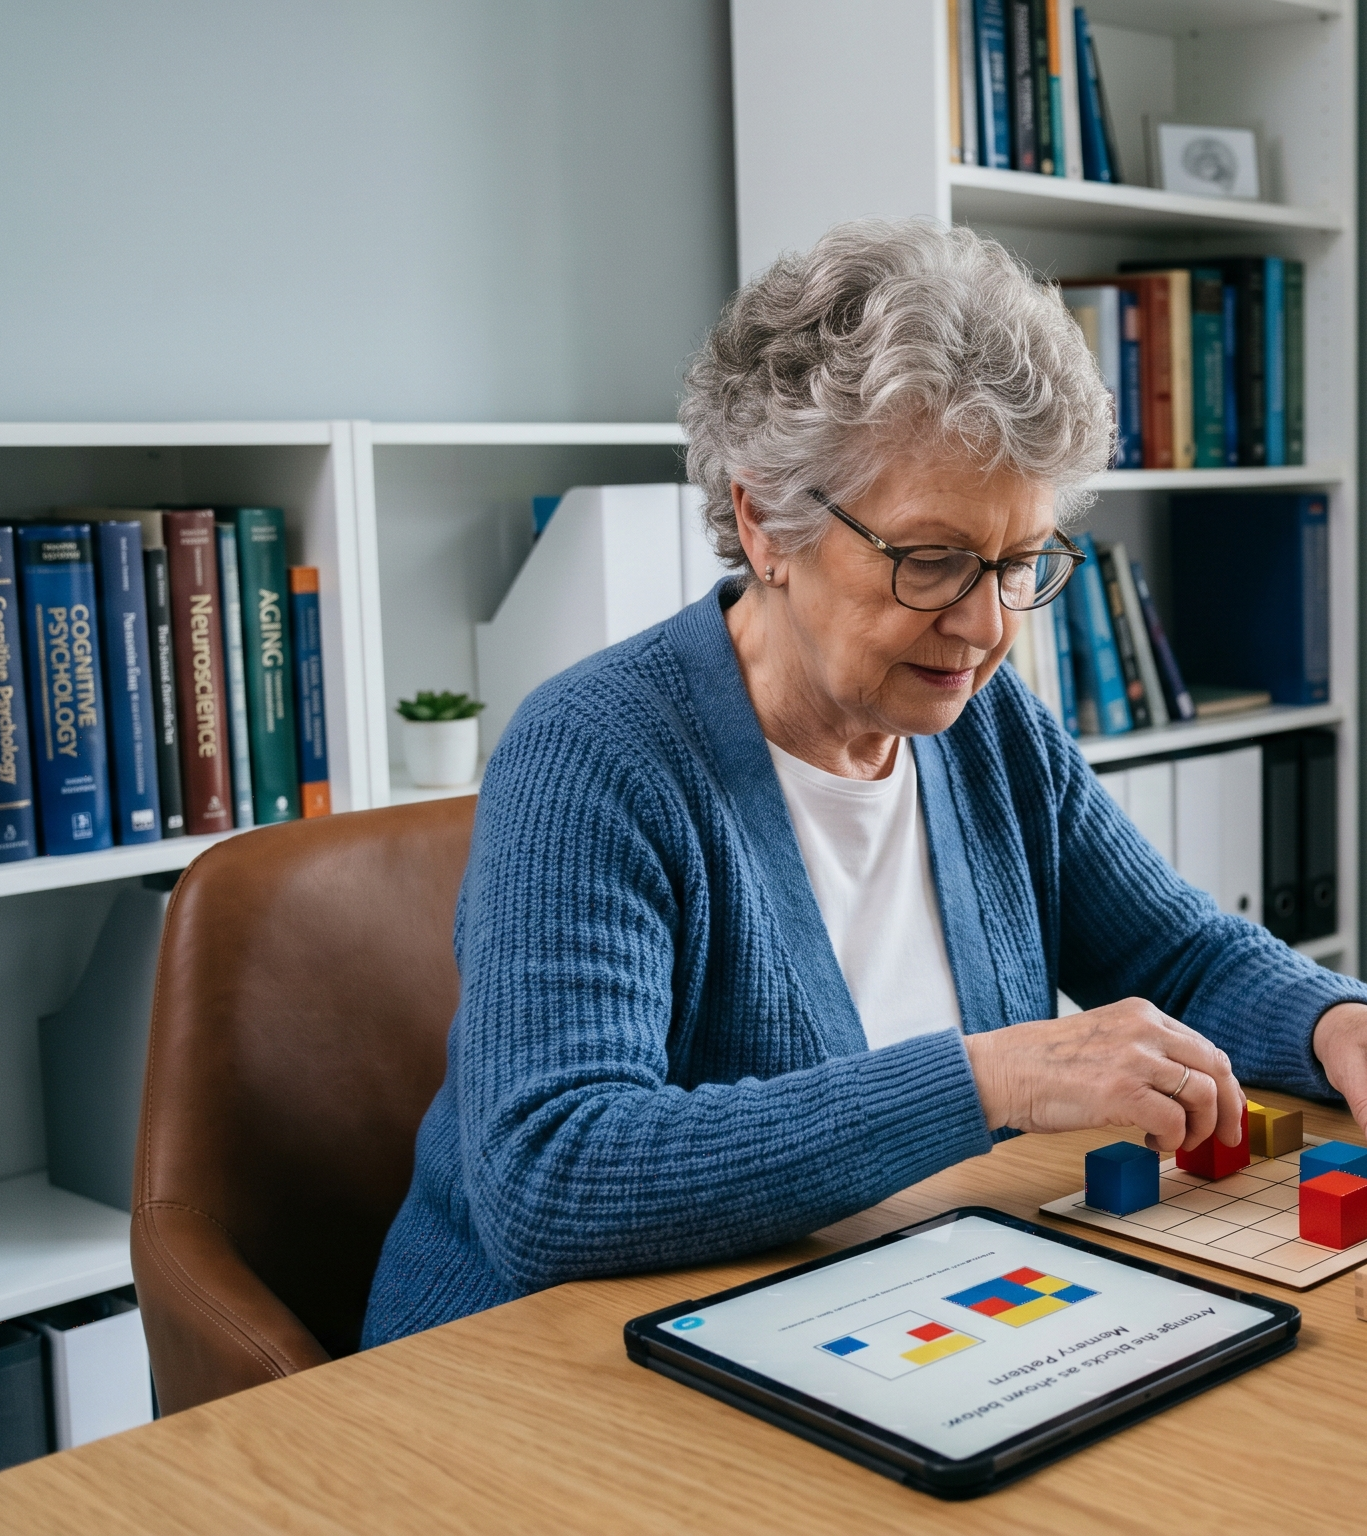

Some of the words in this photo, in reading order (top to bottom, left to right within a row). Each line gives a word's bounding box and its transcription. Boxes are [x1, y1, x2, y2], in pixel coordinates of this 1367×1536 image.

[48, 606, 79, 758] PSYCHOLOGY
[70, 604, 97, 728] COGNITIVE
[190, 594, 217, 758] Neuroscience
[258, 588, 284, 667] AGING
[1081, 1343, 1136, 1367] blocks
